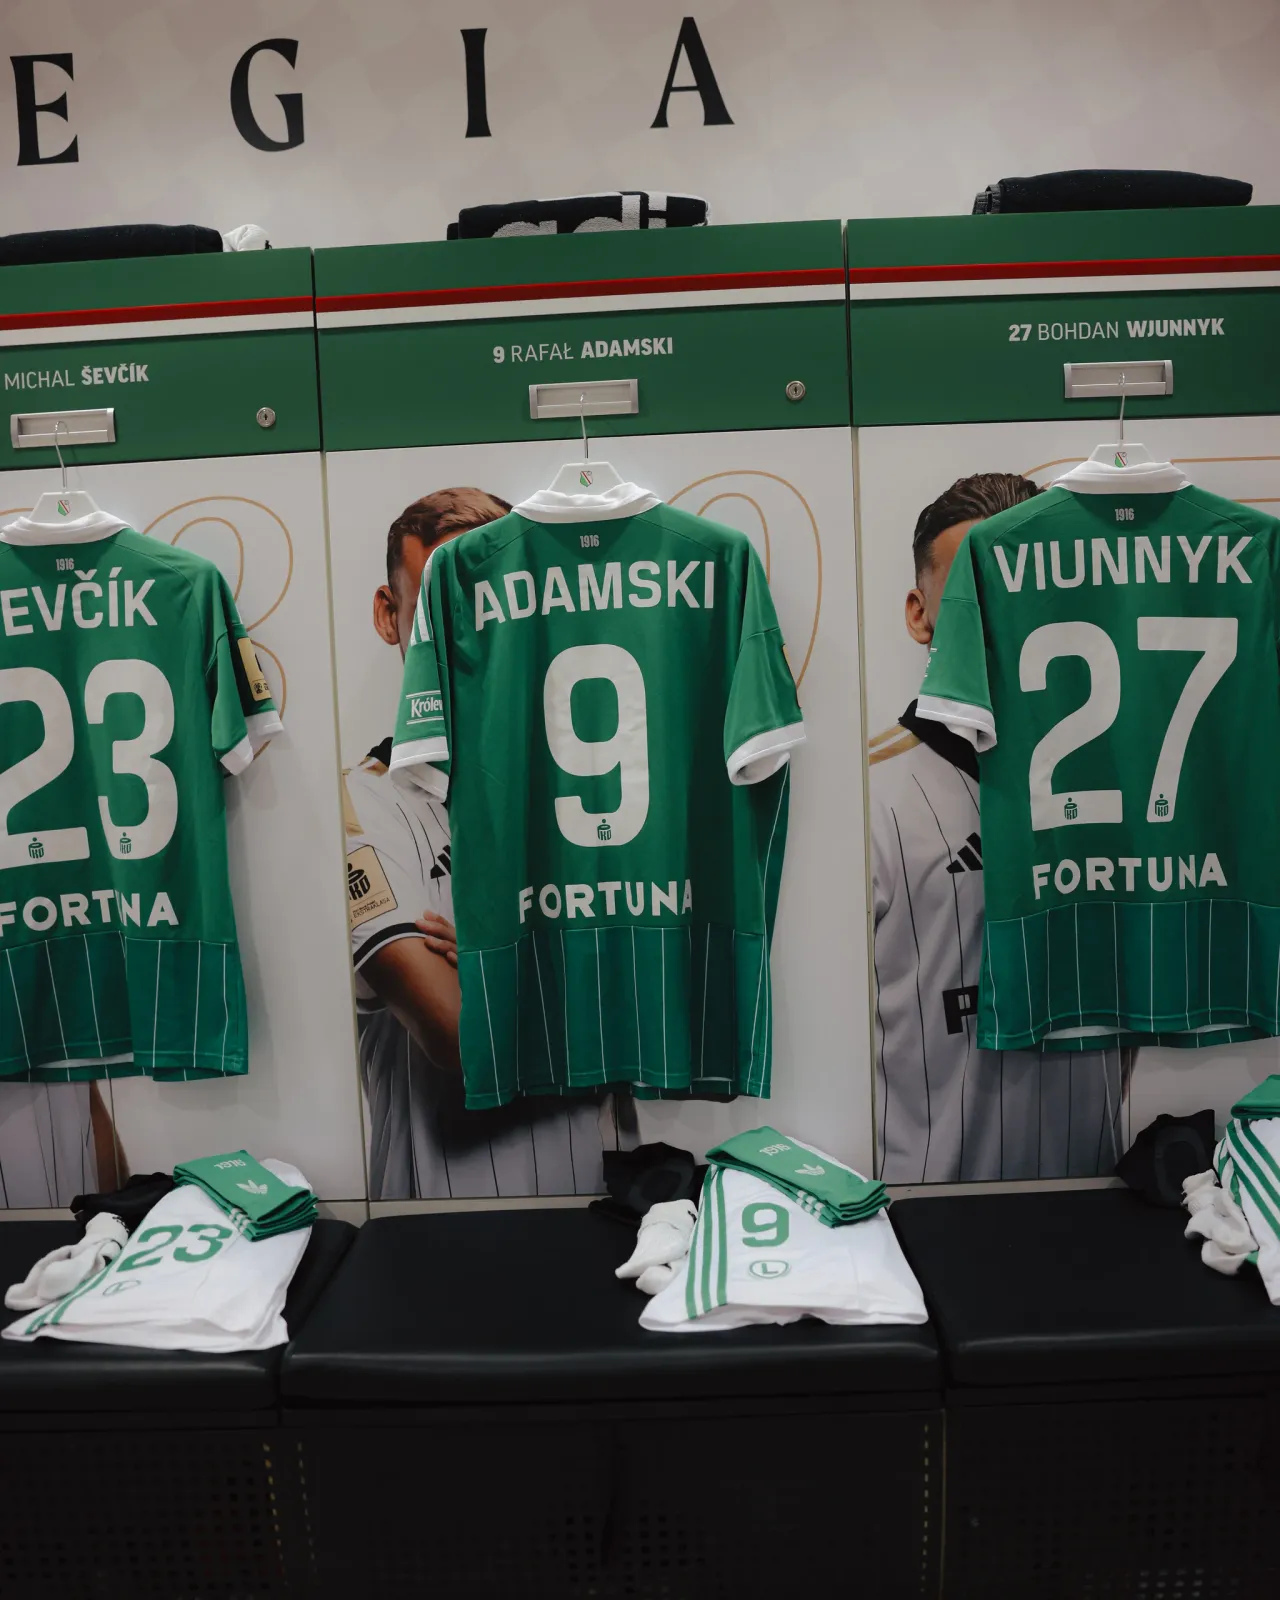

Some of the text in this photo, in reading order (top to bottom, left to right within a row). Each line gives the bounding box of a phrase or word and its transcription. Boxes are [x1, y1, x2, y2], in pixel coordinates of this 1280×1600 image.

[492, 336, 673, 364] 9 RAFAŁ ADAMSKI
[1008, 317, 1225, 342] 27 BOHDAN WJUNNYK
[4, 362, 149, 391] MICHAL ŠEVČÍK
[1114, 508, 1136, 522] 1916
[579, 534, 601, 549] 1916
[993, 535, 1254, 593] VIUNNYK
[55, 557, 76, 572] 1916
[0, 566, 158, 637] EVČÍK
[474, 560, 715, 632] ADAMSKI
[543, 643, 650, 848] 9
[1019, 616, 1239, 831] 27
[0, 658, 179, 870] 23
[1032, 852, 1229, 900] FORTUNA
[518, 879, 693, 924] FORTUNA
[759, 1143, 791, 1156] 1916
[742, 1203, 790, 1247] 9
[116, 1224, 233, 1272] 23
